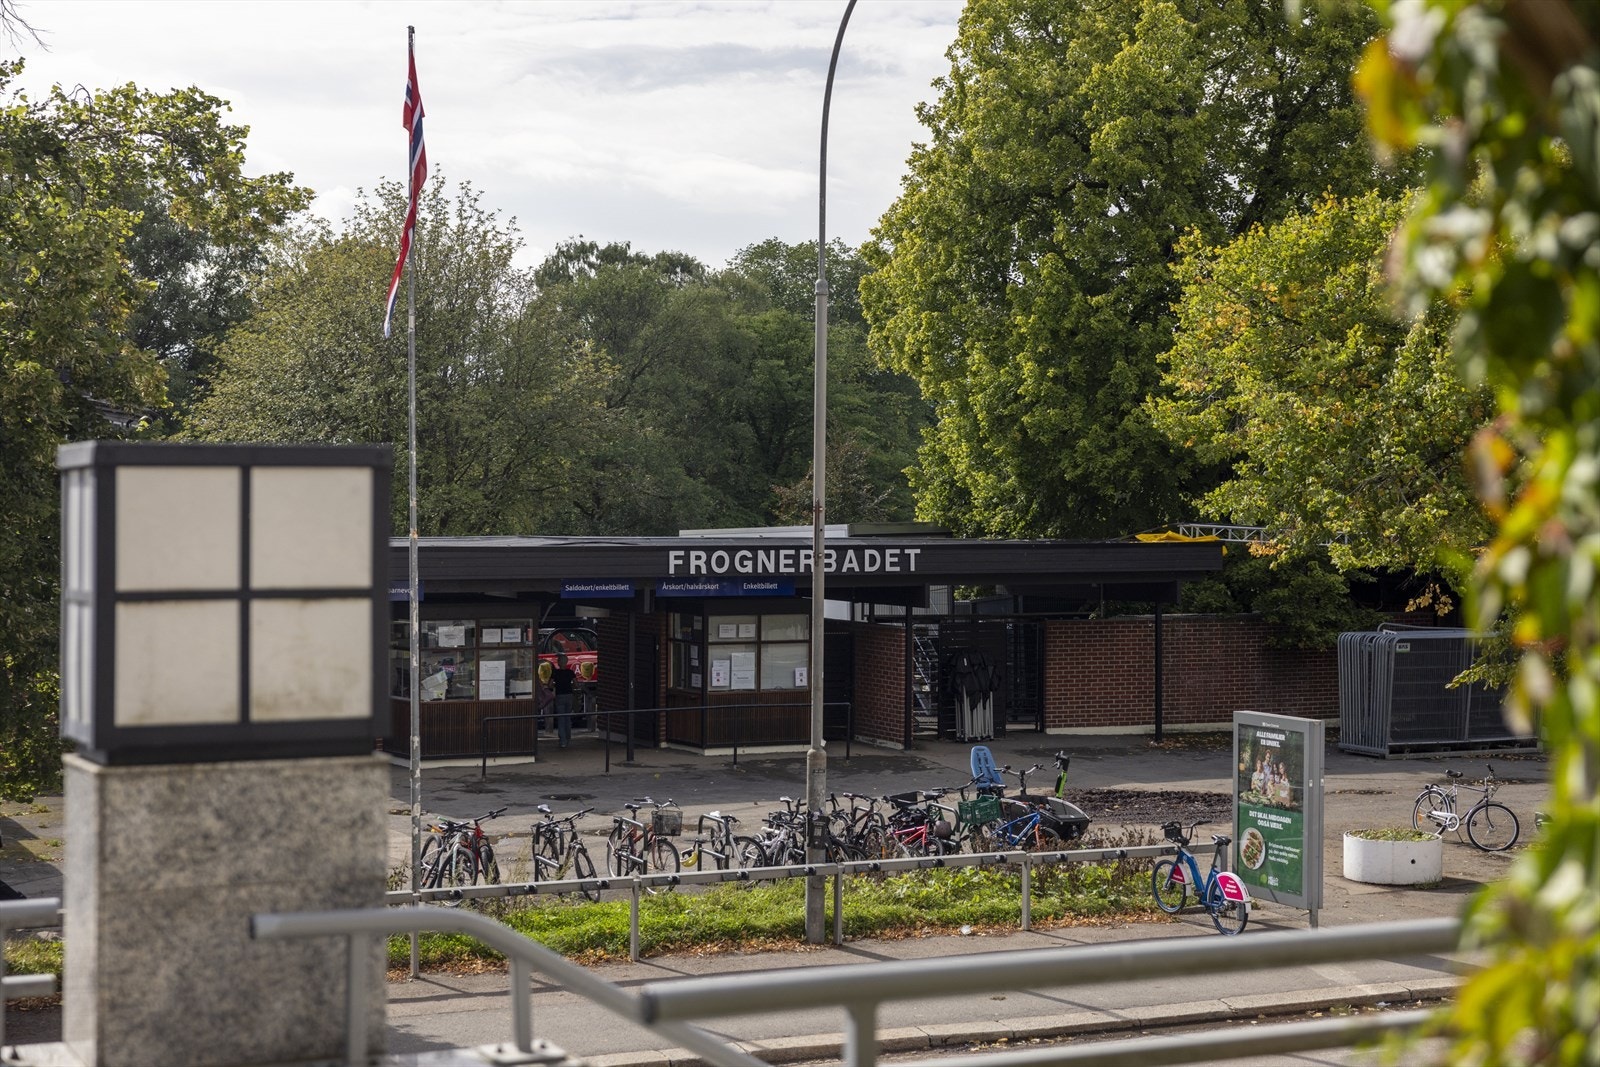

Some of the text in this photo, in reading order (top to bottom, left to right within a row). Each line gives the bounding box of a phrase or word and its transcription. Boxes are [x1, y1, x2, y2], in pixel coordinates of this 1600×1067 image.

[668, 549, 921, 575] FROGNERBADET
[565, 583, 630, 592] Saldokort/enkeltbillett
[661, 581, 720, 591] Årskort/halvårskort
[743, 582, 779, 590] Enkeltbillett
